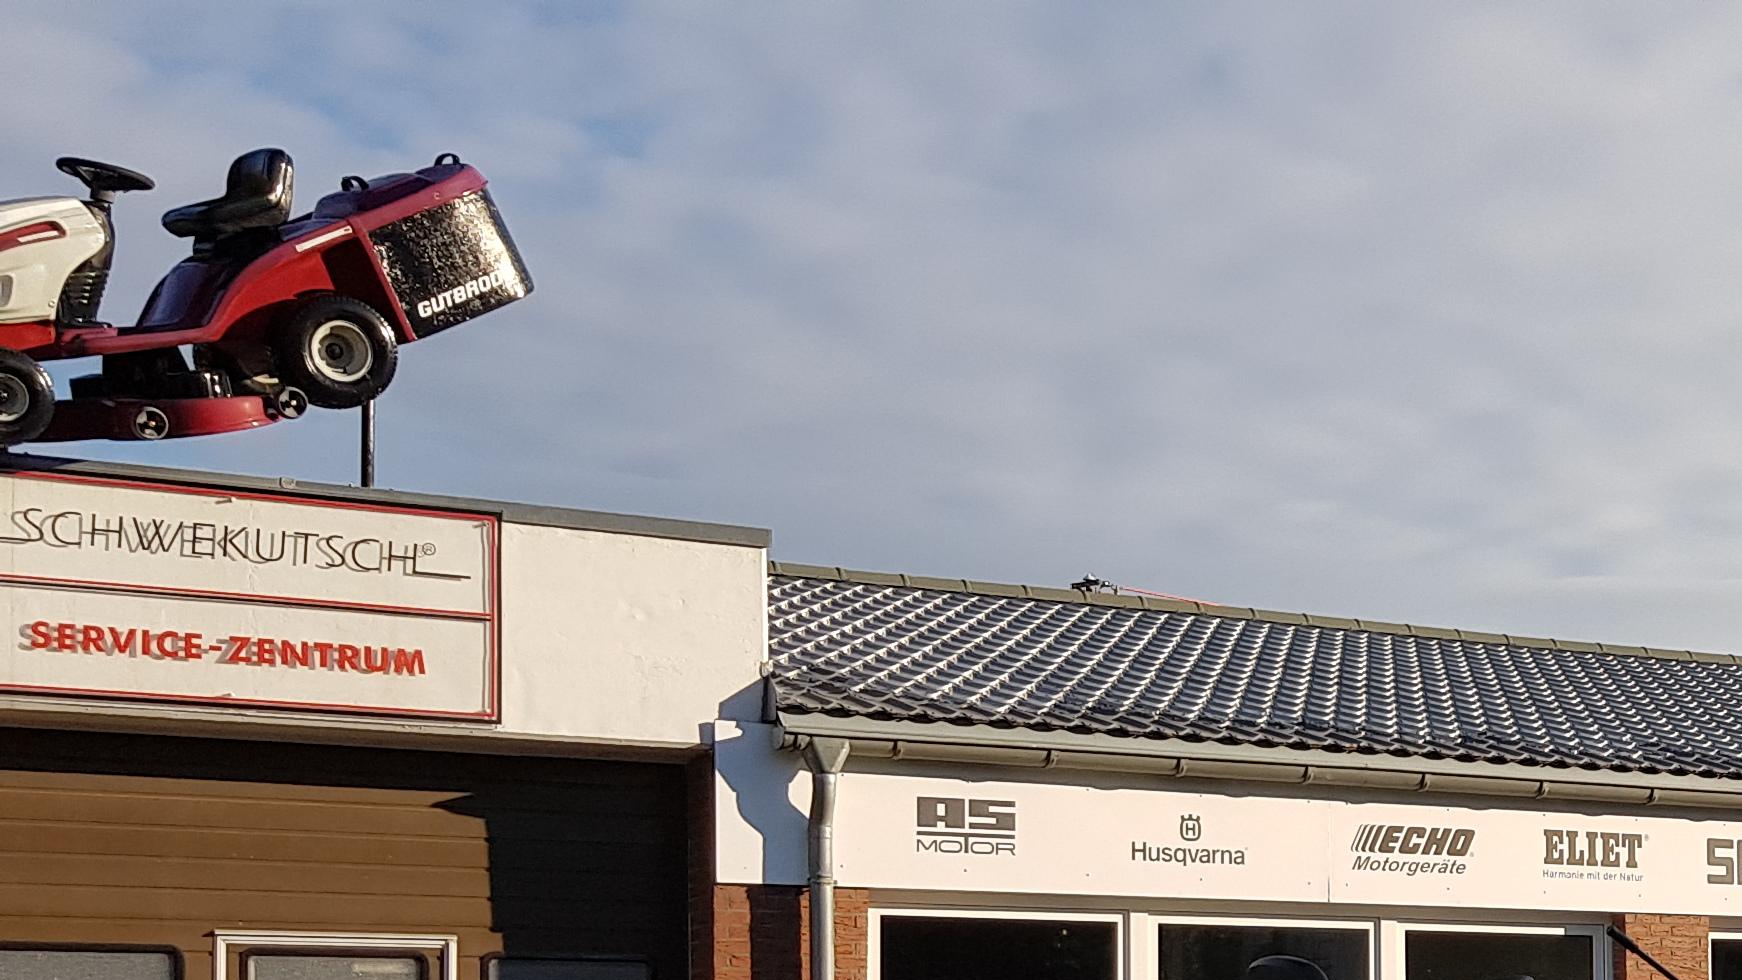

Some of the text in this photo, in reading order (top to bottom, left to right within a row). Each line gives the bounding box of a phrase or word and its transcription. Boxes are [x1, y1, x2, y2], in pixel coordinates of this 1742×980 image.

[417, 270, 504, 318] GUTBROD
[28, 620, 427, 676] SERVICE-ZENTRUM
[916, 796, 1016, 831] AS
[916, 835, 1016, 856] MOTOR
[1131, 841, 1246, 867] Husqvarna
[1377, 825, 1476, 857] ECHO
[1543, 829, 1643, 868] ELIET
[1351, 855, 1467, 877] Motorgeräte
[1586, 870, 1601, 881] mit
[1603, 871, 1618, 881] der
[1619, 872, 1644, 882] Natur
